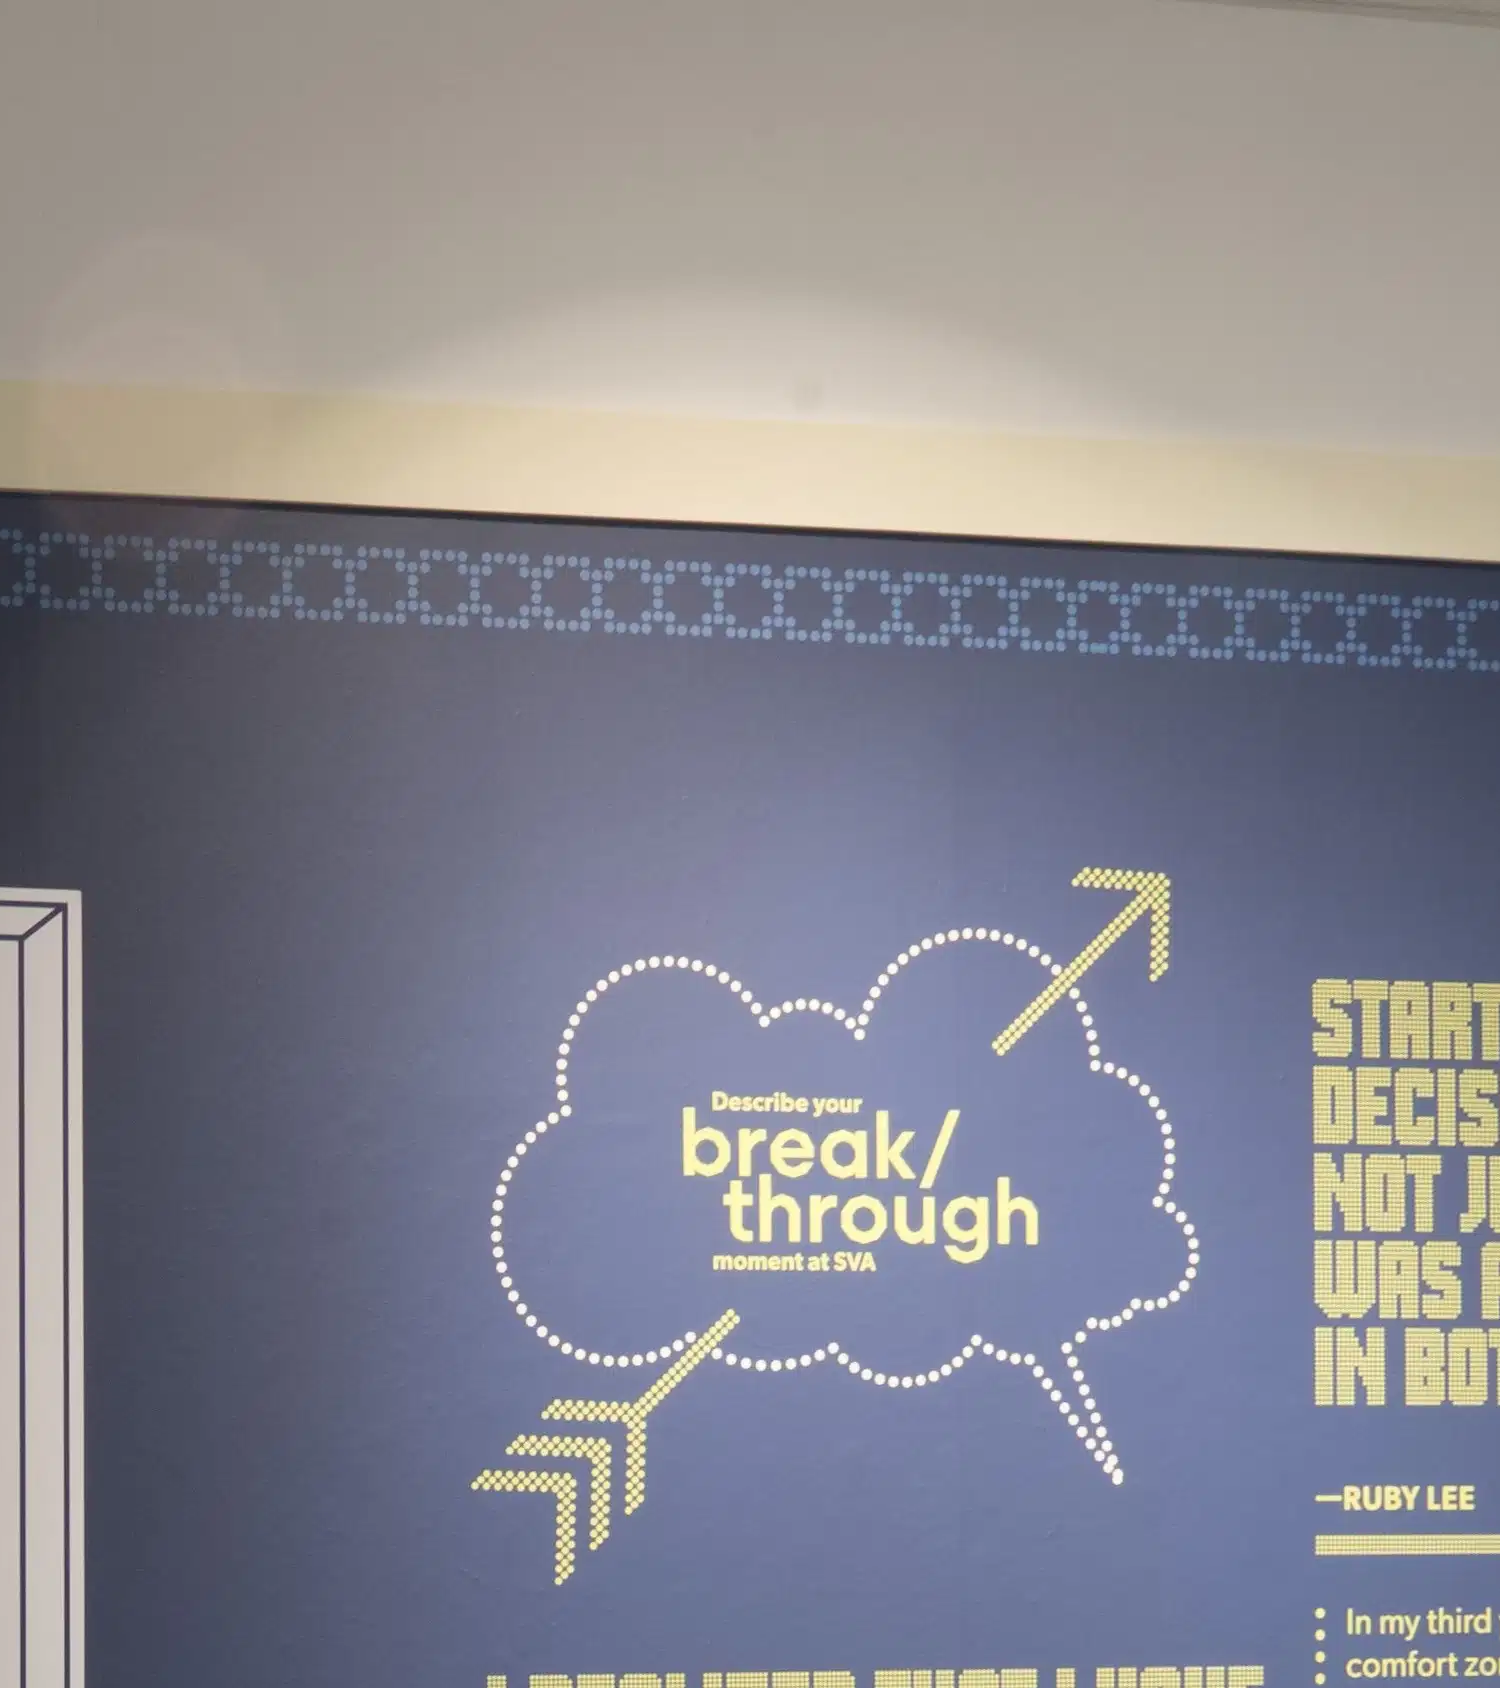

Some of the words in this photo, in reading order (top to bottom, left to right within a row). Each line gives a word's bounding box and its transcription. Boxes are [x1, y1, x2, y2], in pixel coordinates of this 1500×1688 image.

[710, 1091, 810, 1114] Describe
[811, 1098, 864, 1118] your
[1312, 1151, 1442, 1234] NOT
[722, 1175, 1039, 1263] through
[712, 1254, 806, 1273] moment
[807, 1252, 831, 1273] at
[832, 1251, 877, 1273] SVA
[1314, 1239, 1462, 1322] WAS
[1314, 1326, 1387, 1408] IN
[1425, 1484, 1475, 1513] LEE
[1345, 1608, 1374, 1636] In
[1378, 1613, 1421, 1642] my
[1426, 1607, 1494, 1636] third
[1344, 1651, 1459, 1680] comfort
